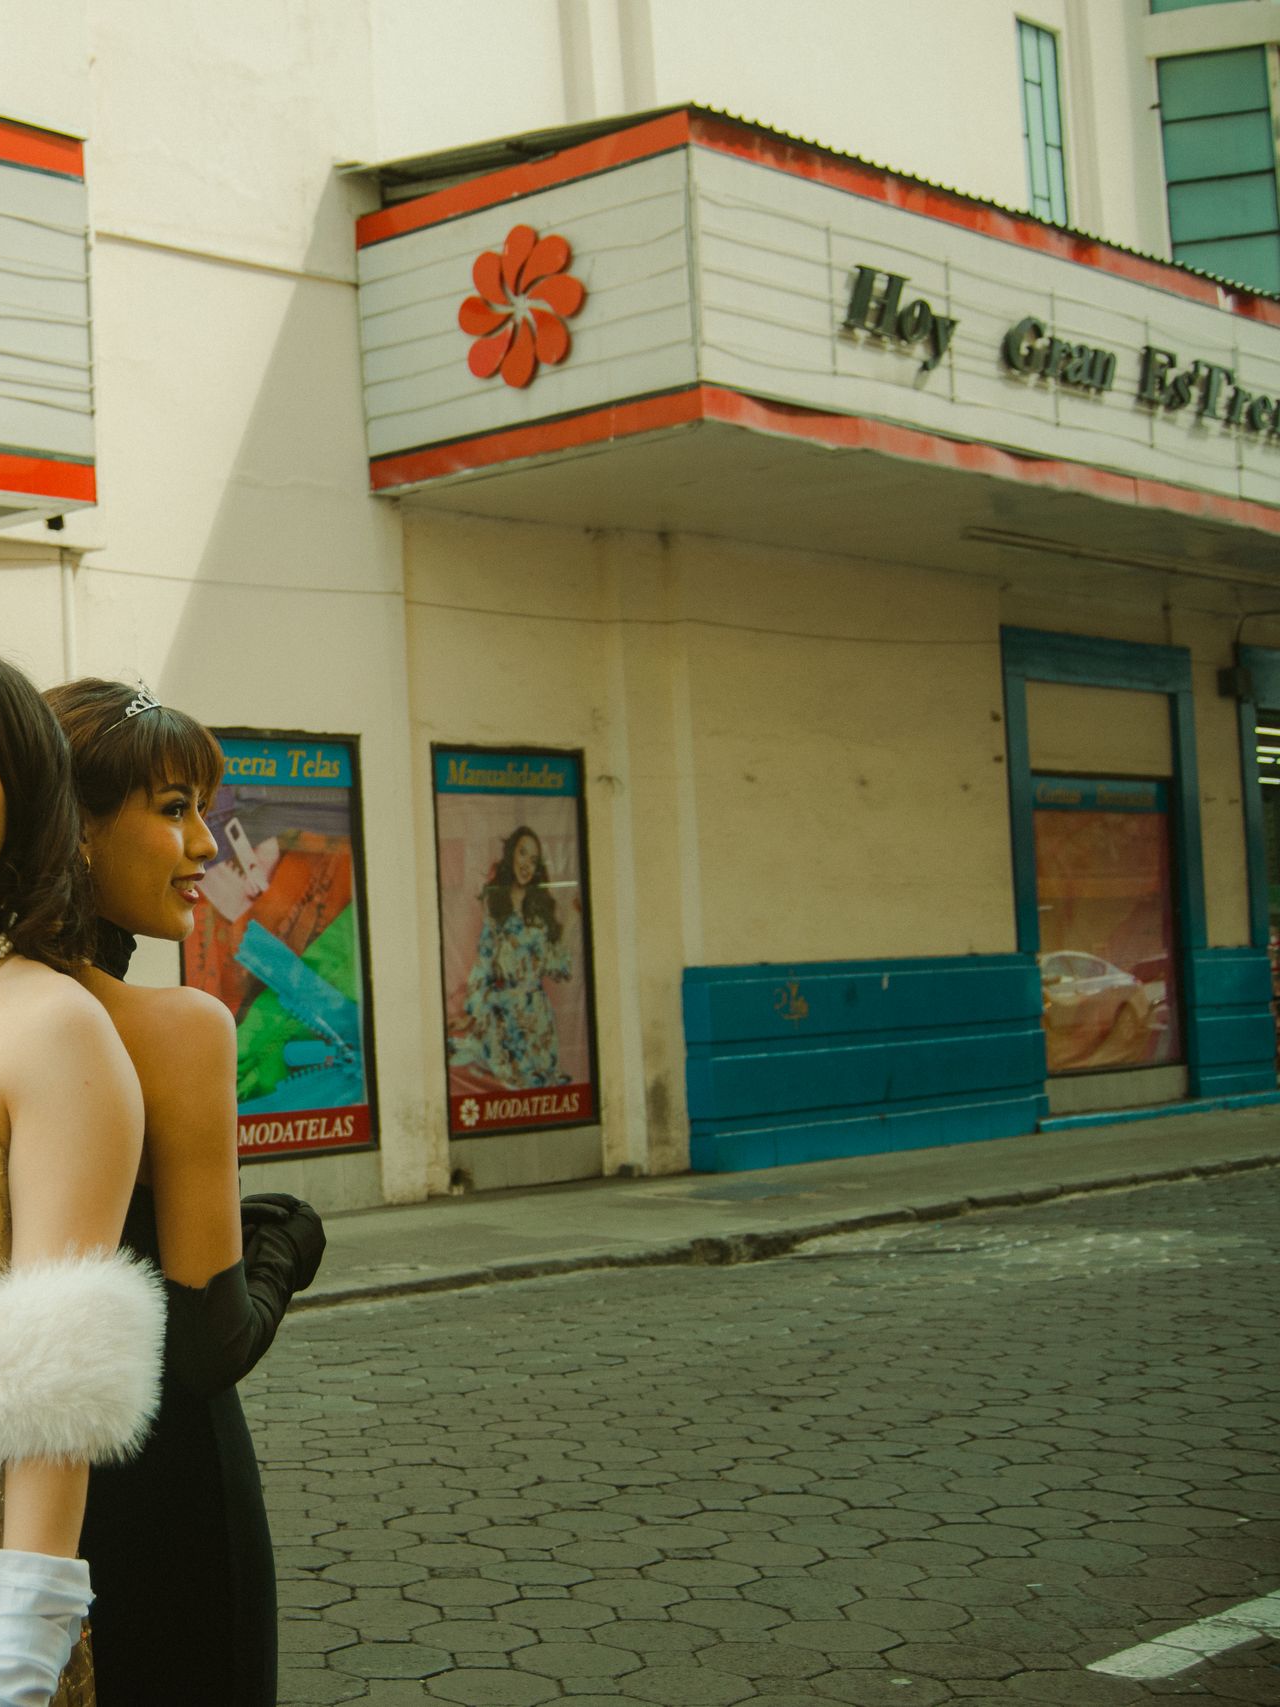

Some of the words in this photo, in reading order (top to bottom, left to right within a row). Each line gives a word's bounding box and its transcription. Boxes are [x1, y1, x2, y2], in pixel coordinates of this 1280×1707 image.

[841, 263, 961, 373] Hoy
[1001, 315, 1117, 392] Gran
[287, 748, 340, 779] Telas
[483, 1092, 580, 1122] MODATELAS
[237, 1114, 355, 1147] MODATELAS
